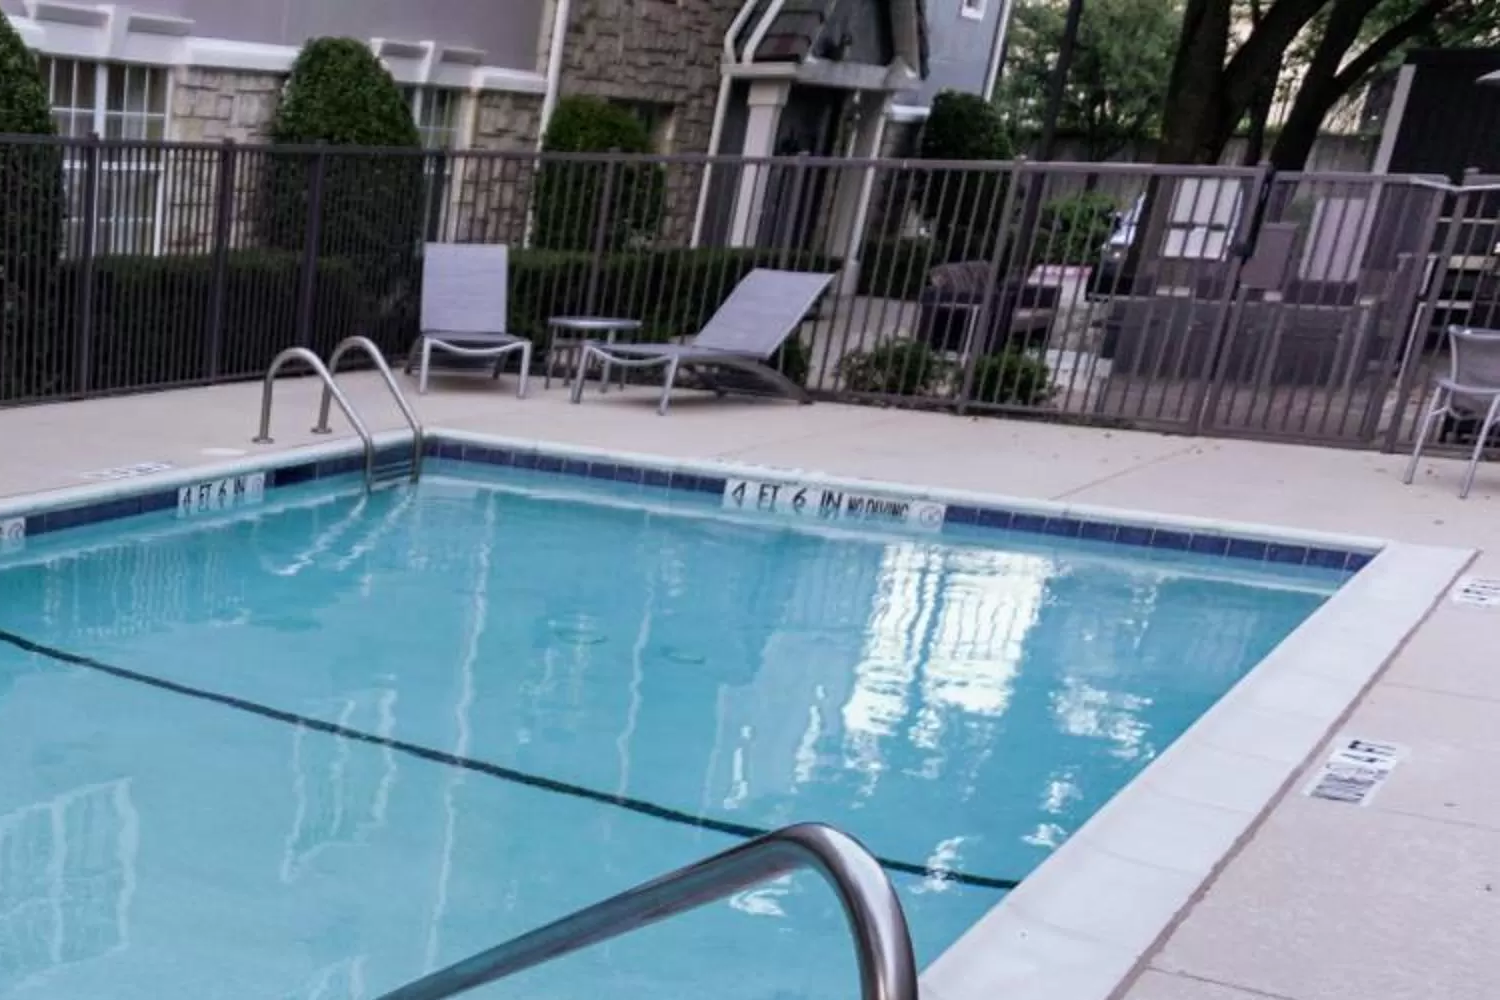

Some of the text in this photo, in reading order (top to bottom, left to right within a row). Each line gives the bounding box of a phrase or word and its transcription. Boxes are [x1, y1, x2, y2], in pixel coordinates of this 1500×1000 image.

[731, 481, 746, 504] 4
[758, 483, 781, 508] FT
[792, 487, 807, 509] 6
[819, 489, 844, 512] IN
